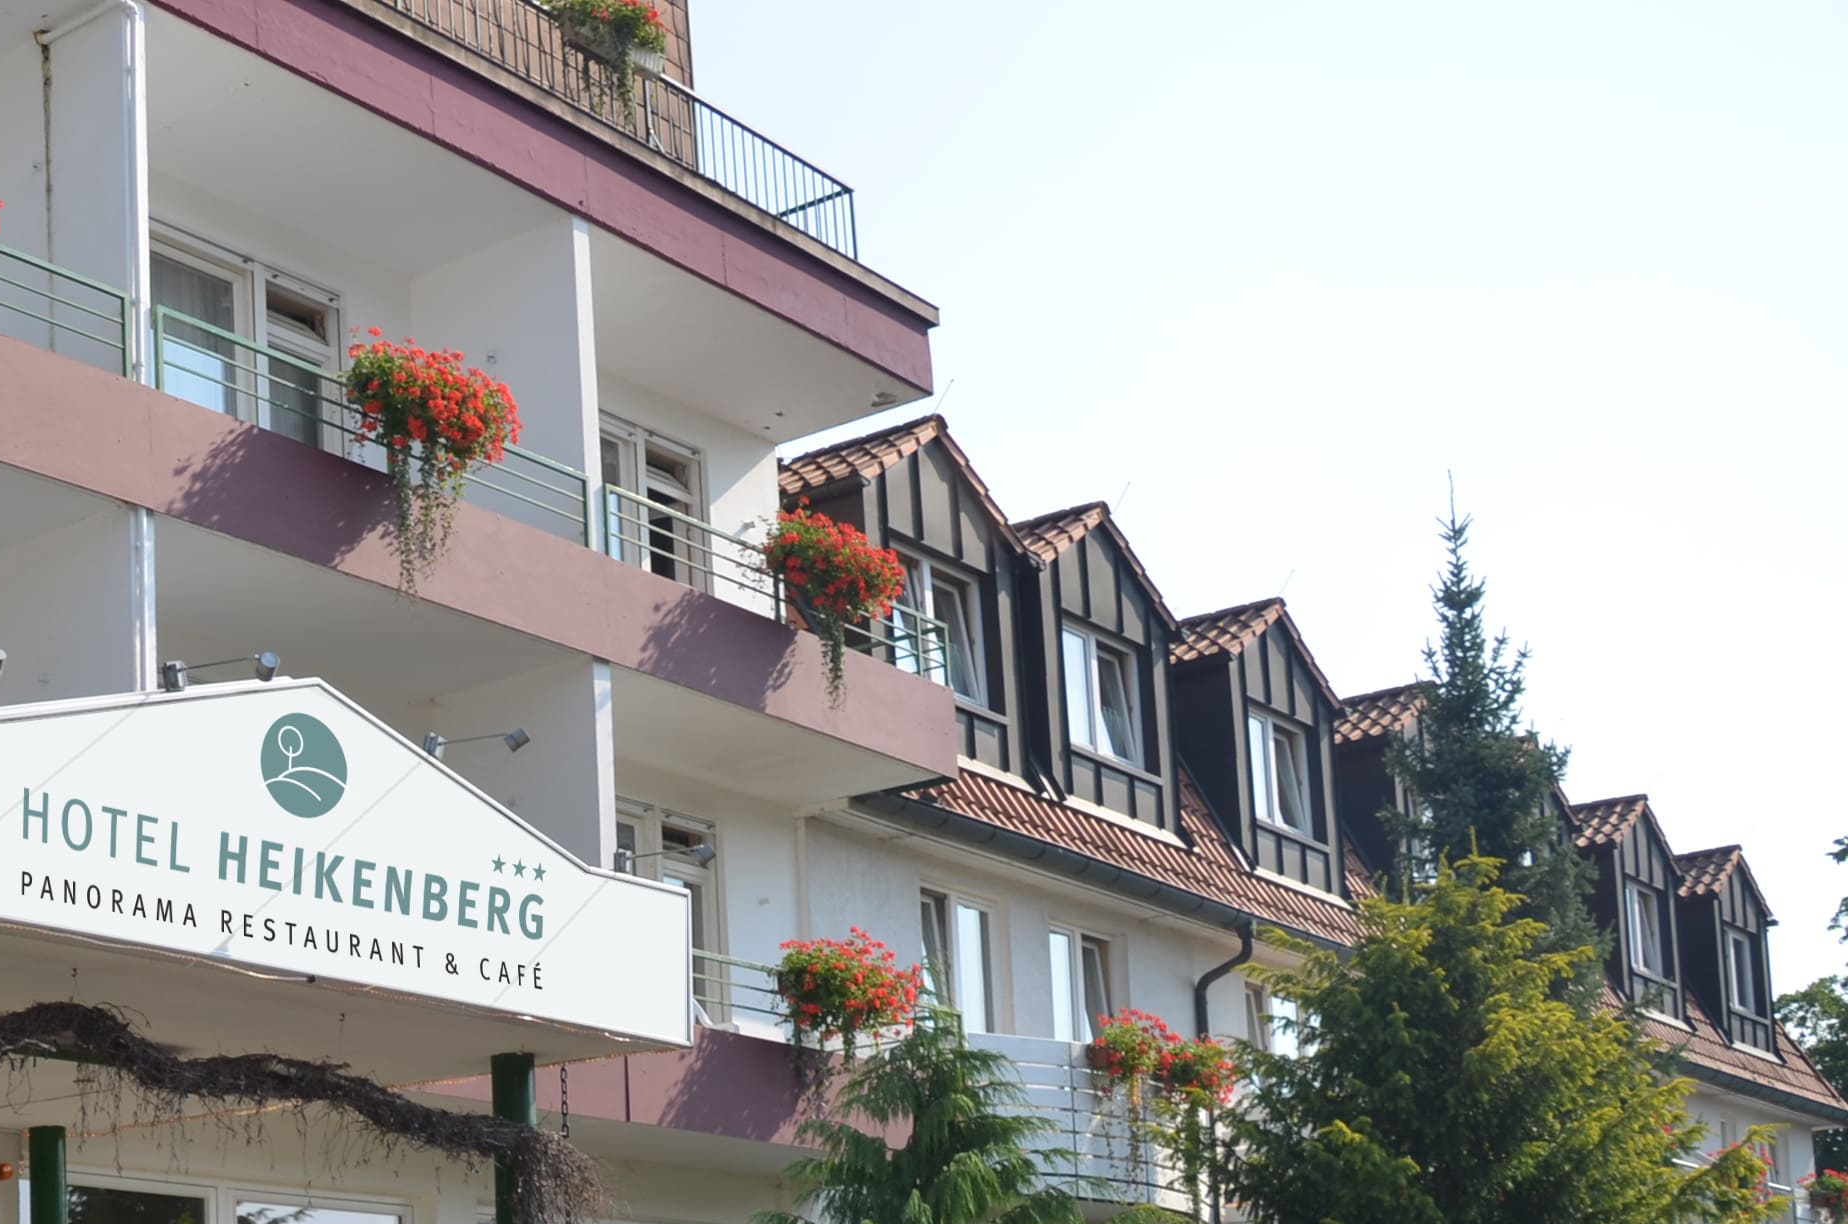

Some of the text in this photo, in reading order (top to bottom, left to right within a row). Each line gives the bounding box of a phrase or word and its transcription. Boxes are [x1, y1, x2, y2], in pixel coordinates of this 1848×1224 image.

[21, 870, 543, 991] PANORAMA RESTAURANT & CAFÉ
[22, 787, 544, 941] HOTEL HEIKENBERG
